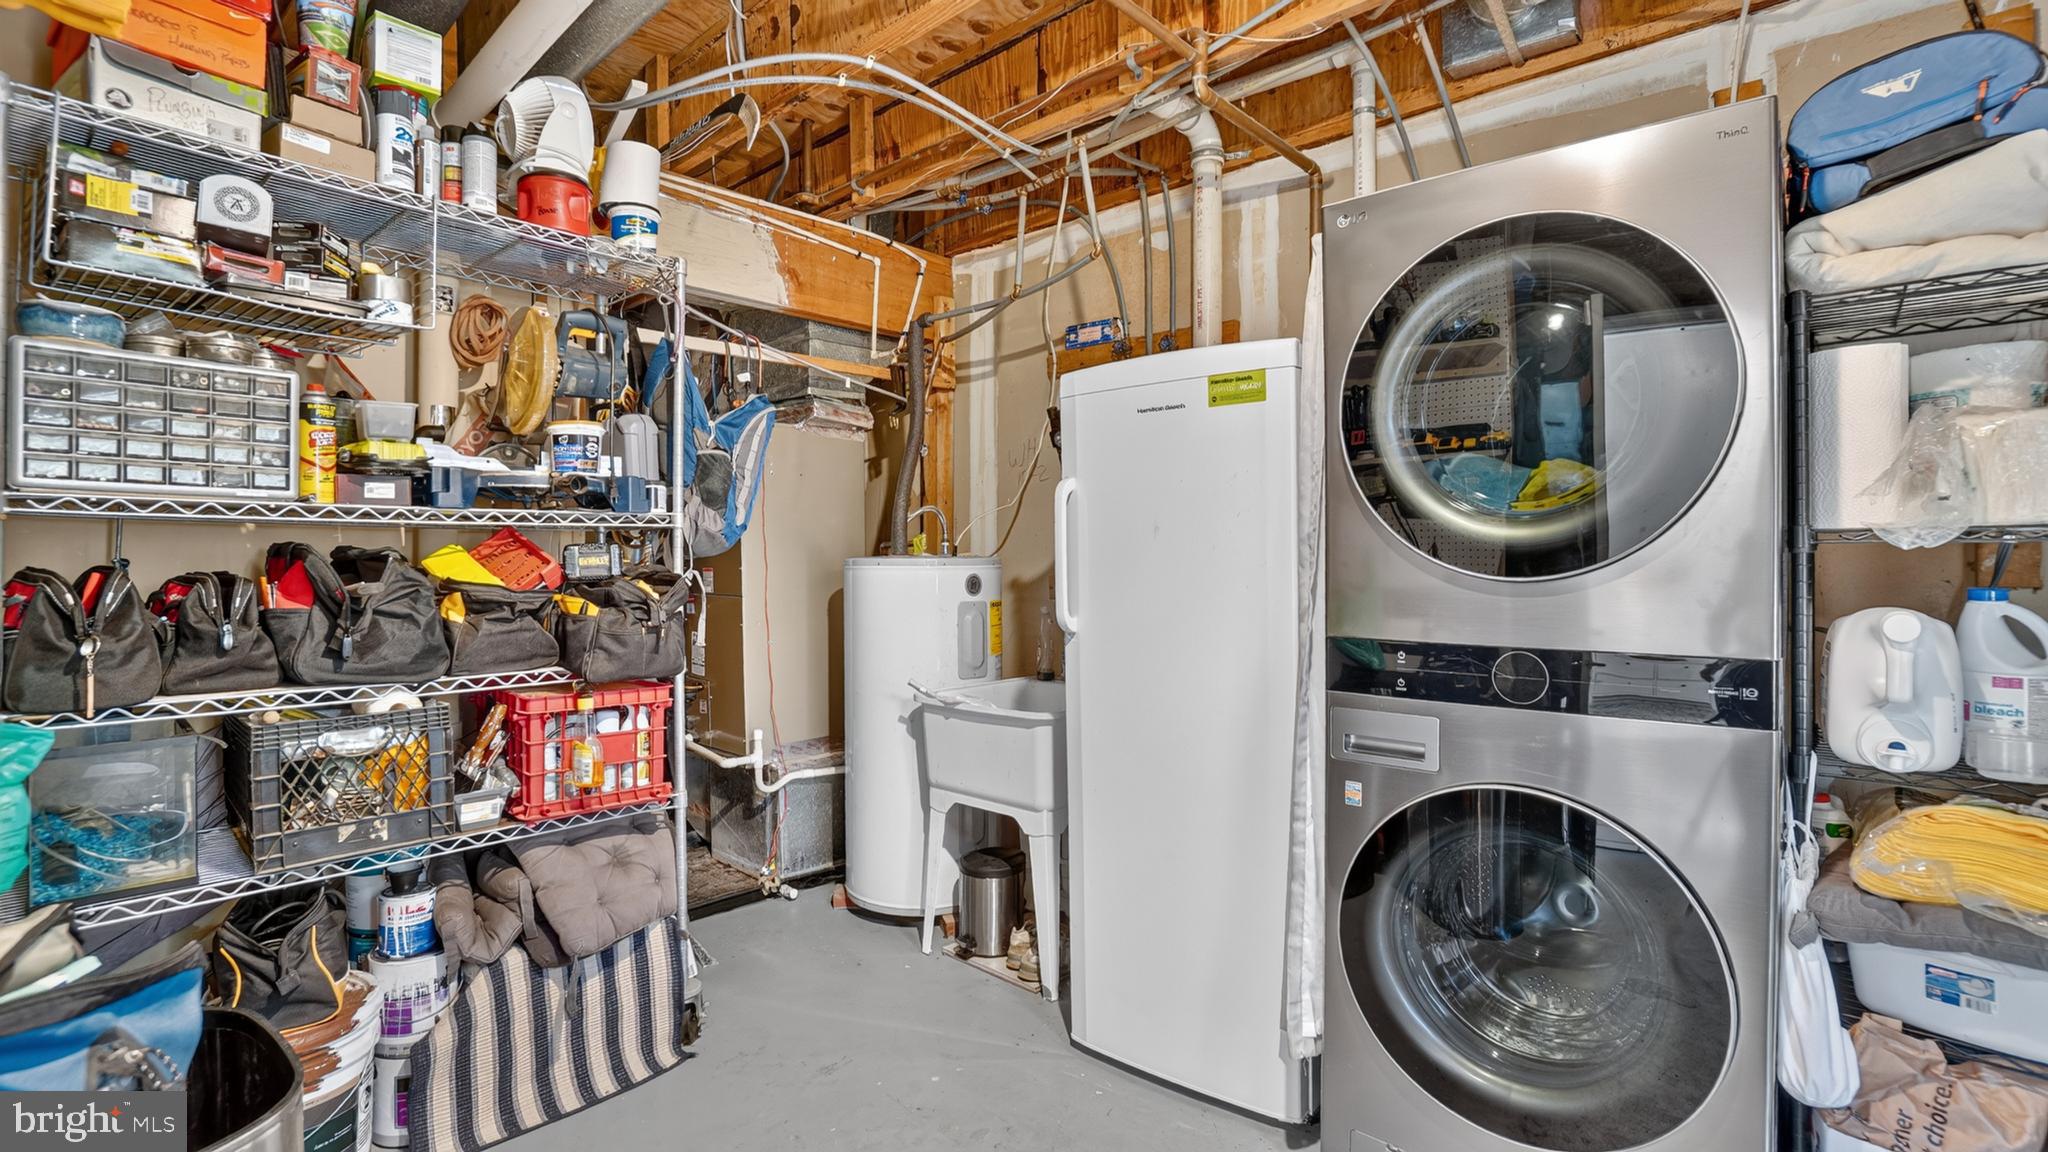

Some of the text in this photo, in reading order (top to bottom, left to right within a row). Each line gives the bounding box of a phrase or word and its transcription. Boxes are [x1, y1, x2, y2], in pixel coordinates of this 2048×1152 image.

[1716, 125, 1750, 140] ThinQ
[1974, 704, 2024, 717] bleach
[1923, 1083, 1953, 1147] choice.
